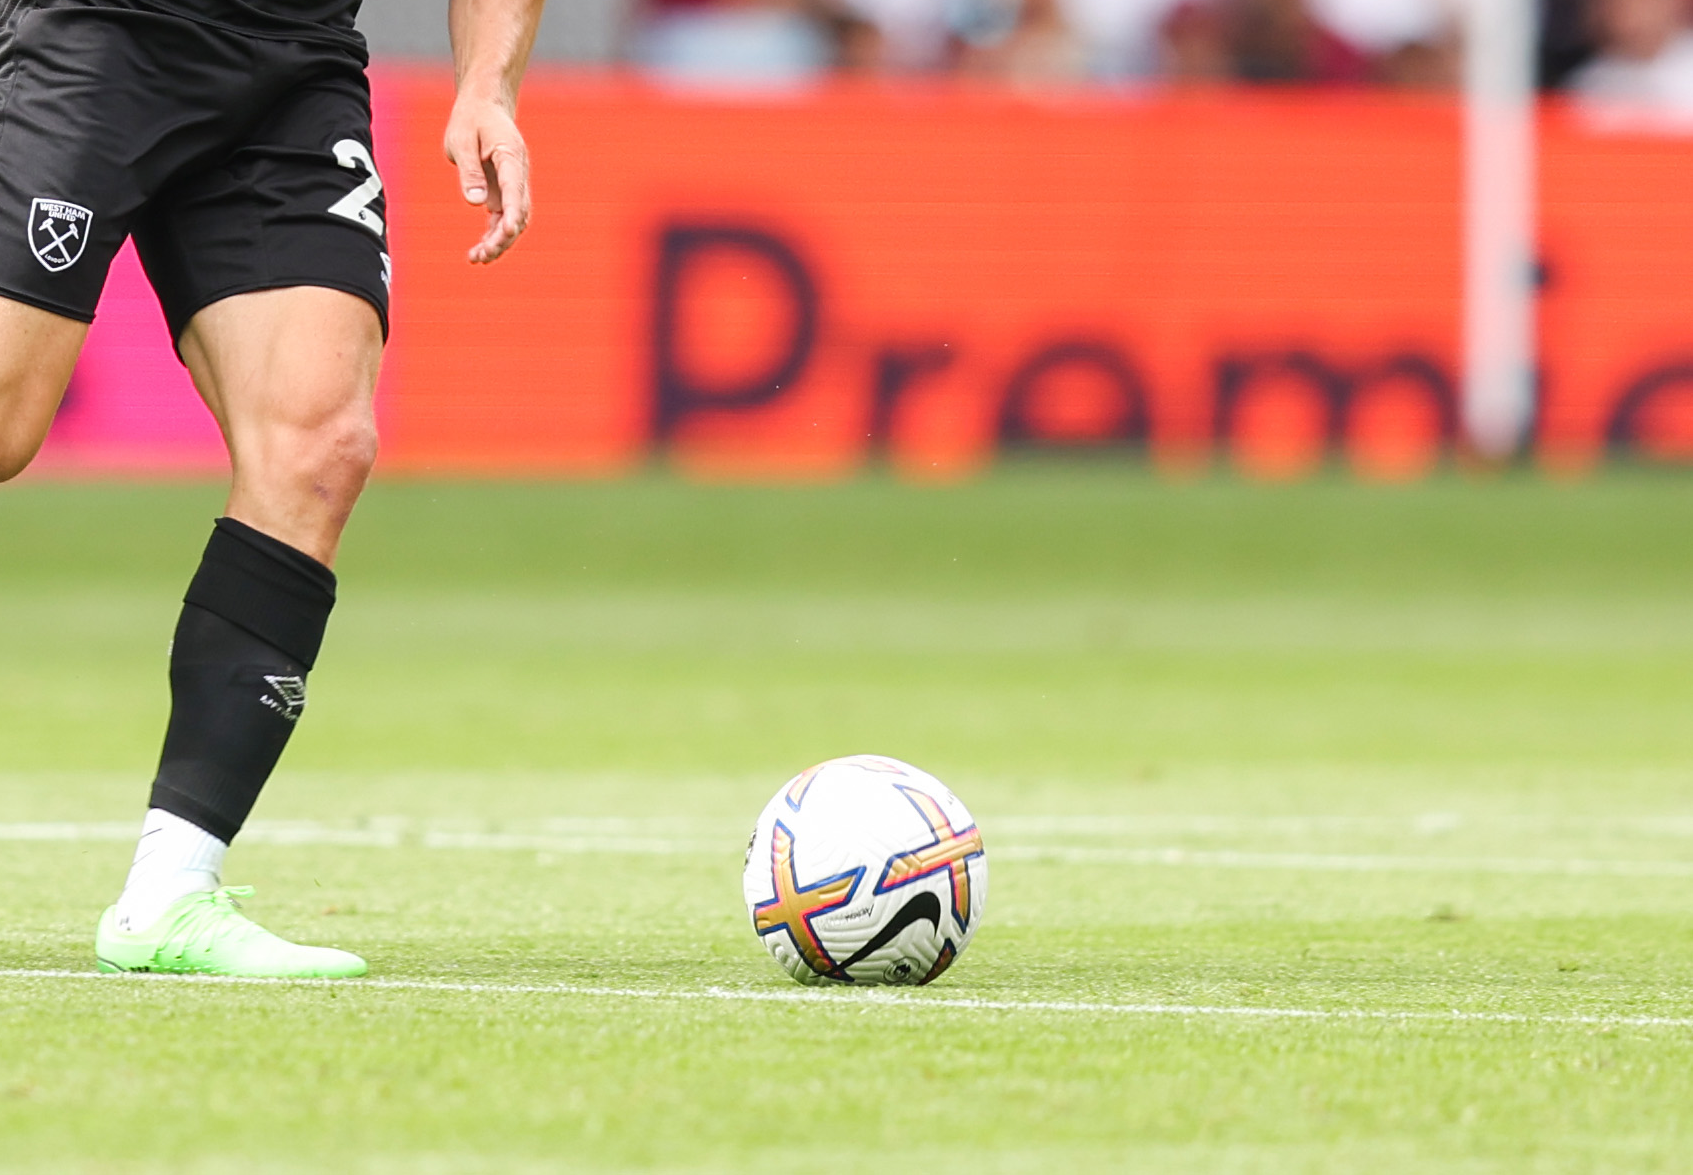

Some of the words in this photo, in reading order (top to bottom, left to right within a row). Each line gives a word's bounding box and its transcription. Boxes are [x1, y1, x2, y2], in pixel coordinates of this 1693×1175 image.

[39, 202, 66, 213] WEST
[65, 206, 86, 221] HAM
[48, 210, 76, 222] UNITED
